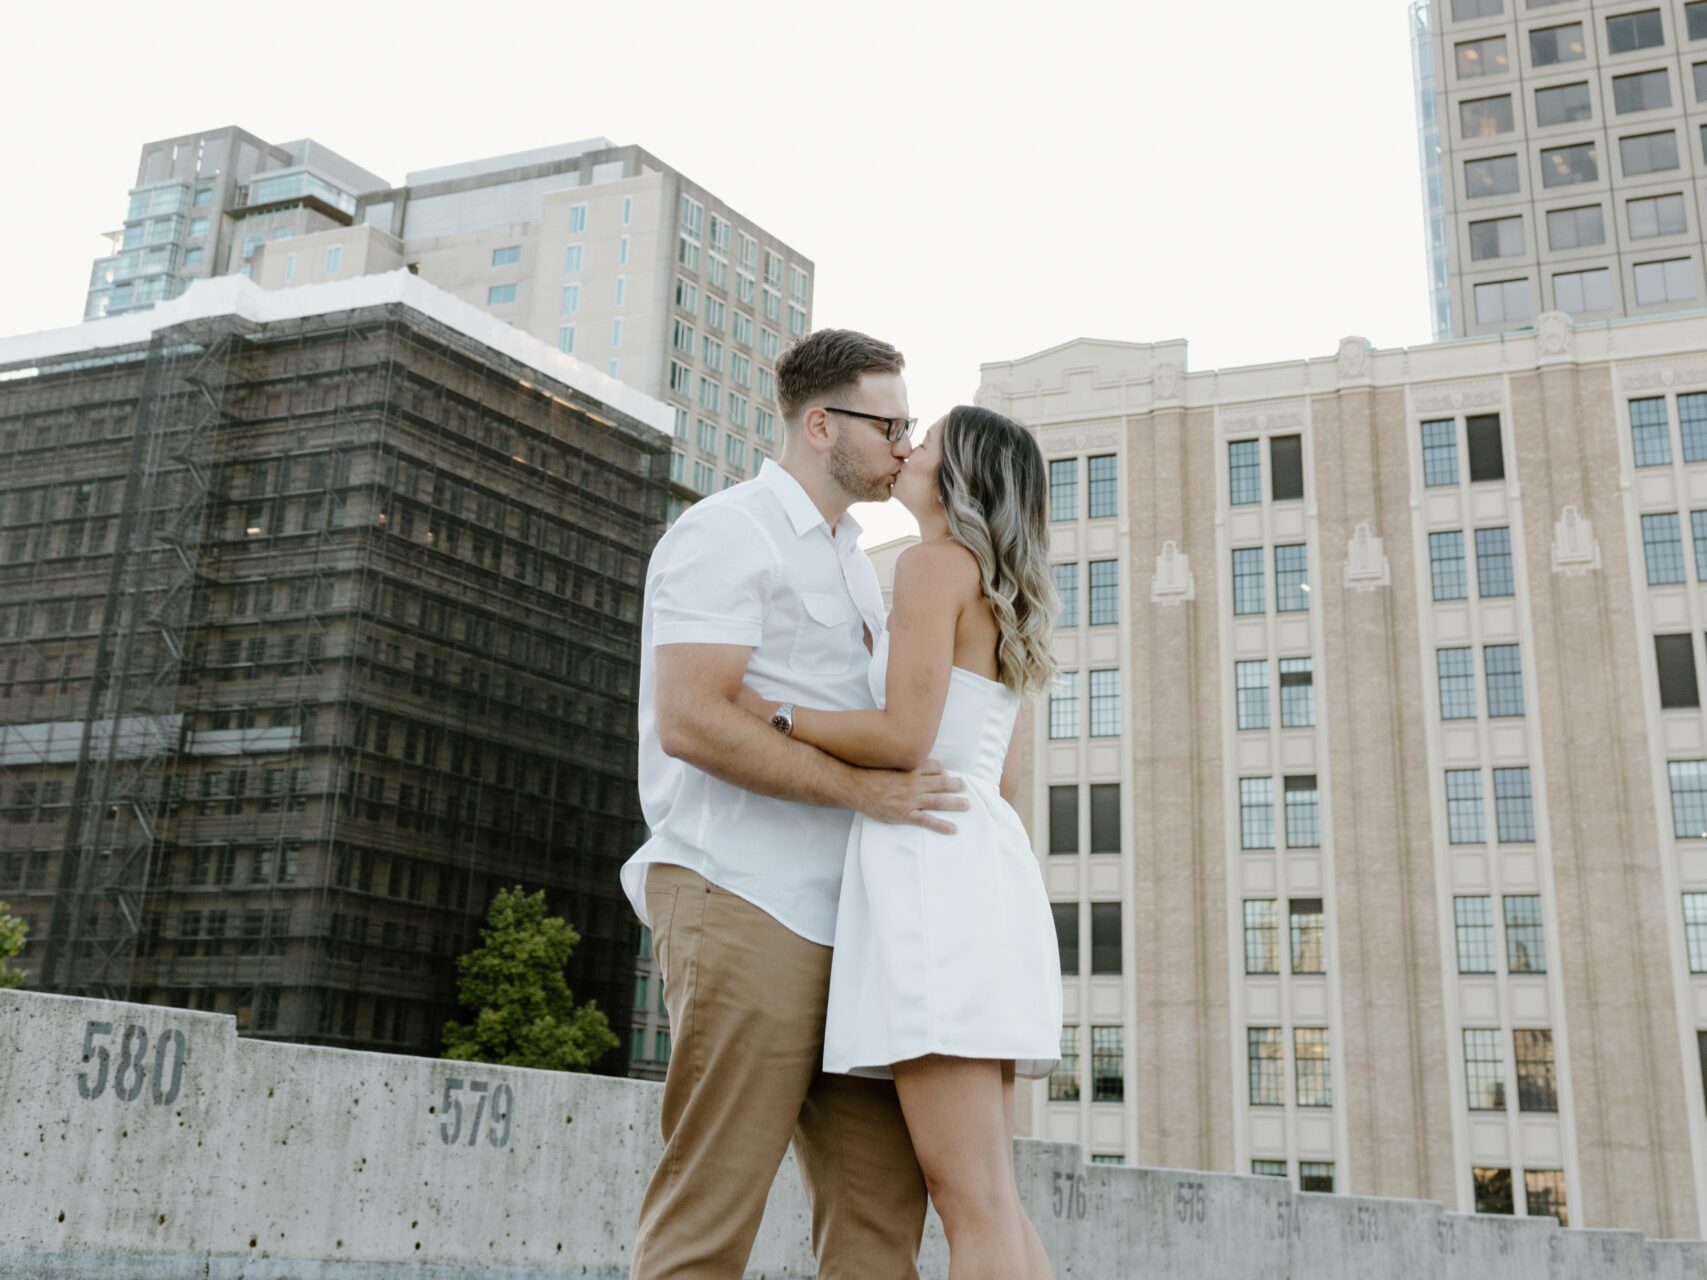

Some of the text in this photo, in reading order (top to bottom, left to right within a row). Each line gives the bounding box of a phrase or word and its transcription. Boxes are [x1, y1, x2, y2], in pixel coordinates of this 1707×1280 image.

[78, 1020, 186, 1106] 580
[441, 1078, 513, 1148] 579
[1053, 1172, 1087, 1220] 576
[1177, 1181, 1206, 1224] 575
[1278, 1200, 1302, 1240] 574
[1357, 1206, 1380, 1243] 573
